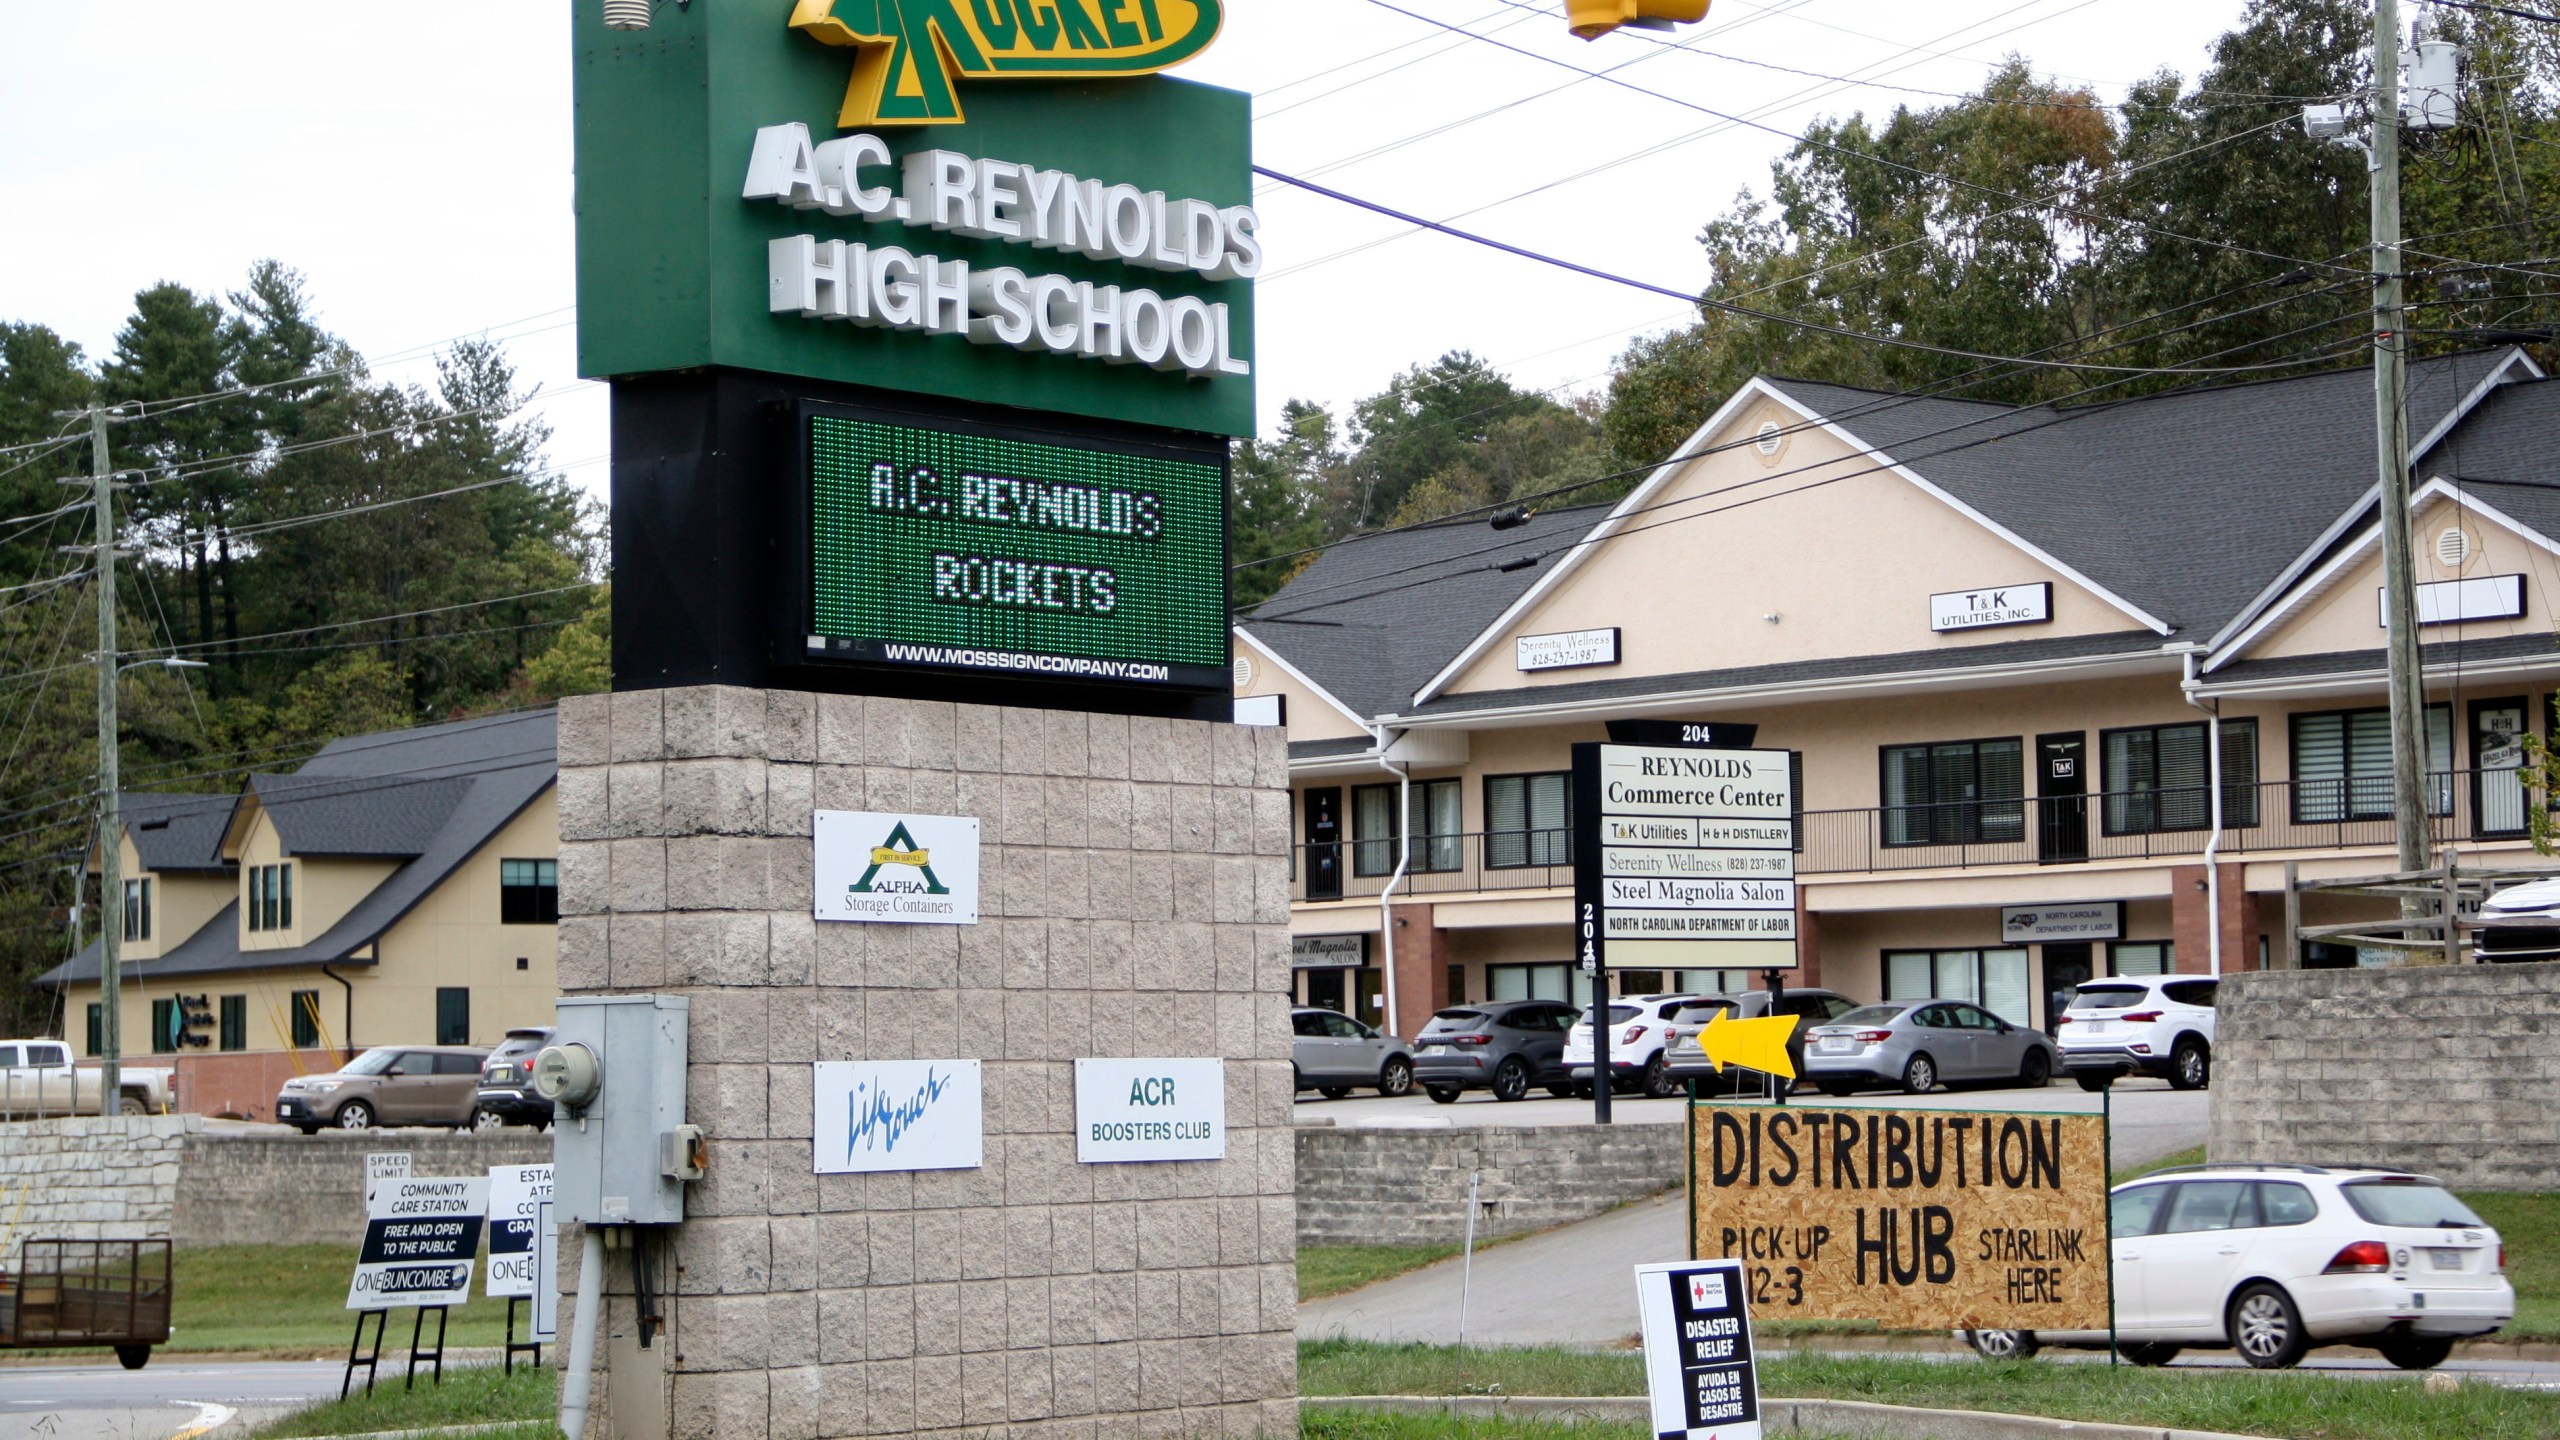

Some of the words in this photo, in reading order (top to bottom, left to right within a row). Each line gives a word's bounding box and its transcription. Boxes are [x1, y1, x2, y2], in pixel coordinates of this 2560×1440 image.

[743, 122, 911, 226] A.C.
[903, 149, 1262, 281] REYNOLDS
[768, 234, 968, 333] HIGH
[966, 266, 1250, 378] SCHOOL
[870, 463, 949, 514] A.C.
[962, 474, 1161, 537] REYNOLDS
[934, 554, 1116, 612] ROCKETS
[1966, 591, 2008, 611] T&K
[1942, 611, 2005, 626] UTILITIES,
[2008, 608, 2034, 619] INC.
[1520, 638, 1560, 654] Serenity
[1567, 631, 1610, 649] Wellness
[884, 643, 1168, 681] WWW.MOSSSIGNCOMPANY.COM
[1532, 648, 1598, 666] 828-237-1987
[1682, 725, 1710, 742] 204
[1641, 756, 1752, 779] REYNOLDS
[1608, 781, 1715, 805] Commerce
[1720, 784, 1785, 807] Center
[1611, 823, 1638, 839] T&K
[1641, 823, 1688, 840] Utilities
[1703, 828, 1710, 839] H
[1713, 828, 1720, 838] &
[1723, 828, 1730, 839] H
[1733, 828, 1789, 840] DISTILLERY
[1609, 852, 1663, 874] Serenity
[1666, 853, 1722, 872] Wellness
[1727, 857, 1748, 871] (828)
[1750, 858, 1786, 870] 237-1987
[873, 881, 926, 894] ALPHA
[1612, 880, 1652, 899] Steel
[1658, 881, 1734, 906] Magnolia
[1741, 882, 1785, 901] Salon
[845, 895, 890, 916] Storage
[893, 896, 954, 914] Containers
[2045, 911, 2068, 920] NORTH
[2069, 910, 2102, 918] CAROLINA
[1609, 917, 1639, 930] NORTH
[1642, 918, 1686, 931] CAROLINA
[1689, 918, 1746, 932] DEPARTMENT
[1748, 919, 1759, 931] OF
[1761, 919, 1790, 931] LABOR
[2035, 924, 2077, 934] DEPARTMENT
[2080, 924, 2088, 932] OF
[2090, 923, 2113, 931] LABOR
[1309, 938, 1357, 958] Magnolia
[1129, 1077, 1176, 1106] ACR
[1092, 1122, 1172, 1141] BOOSTERS
[1174, 1121, 1211, 1140] CLUB
[1712, 1111, 2061, 1190] DISTRIBUTION
[370, 1156, 409, 1166] SPEED
[373, 1169, 404, 1178] LIMIT
[520, 1169, 554, 1183] ESTA
[400, 1183, 468, 1197] COMMUNITY
[391, 1201, 420, 1213] CARE
[421, 1200, 469, 1213] STATION
[384, 1225, 410, 1238] FREE
[409, 1224, 433, 1236] AND
[435, 1223, 464, 1235] OPEN
[383, 1243, 398, 1255] TO
[399, 1242, 417, 1254] THE
[418, 1240, 457, 1253] PUBLIC
[1722, 1225, 1830, 1262] PICK-UP
[1856, 1205, 1956, 1286] HUB
[1978, 1228, 2086, 1263] STARLINK
[2007, 1267, 2063, 1304] HERE
[1685, 1317, 1739, 1338] DISASTER
[1696, 1339, 1734, 1359] RELIEF
[1698, 1371, 1727, 1388] AYUDA
[1728, 1370, 1740, 1385] EN
[1699, 1387, 1729, 1404] CASOS
[1730, 1387, 1742, 1401] DE
[1700, 1402, 1744, 1420] DESASTRE
